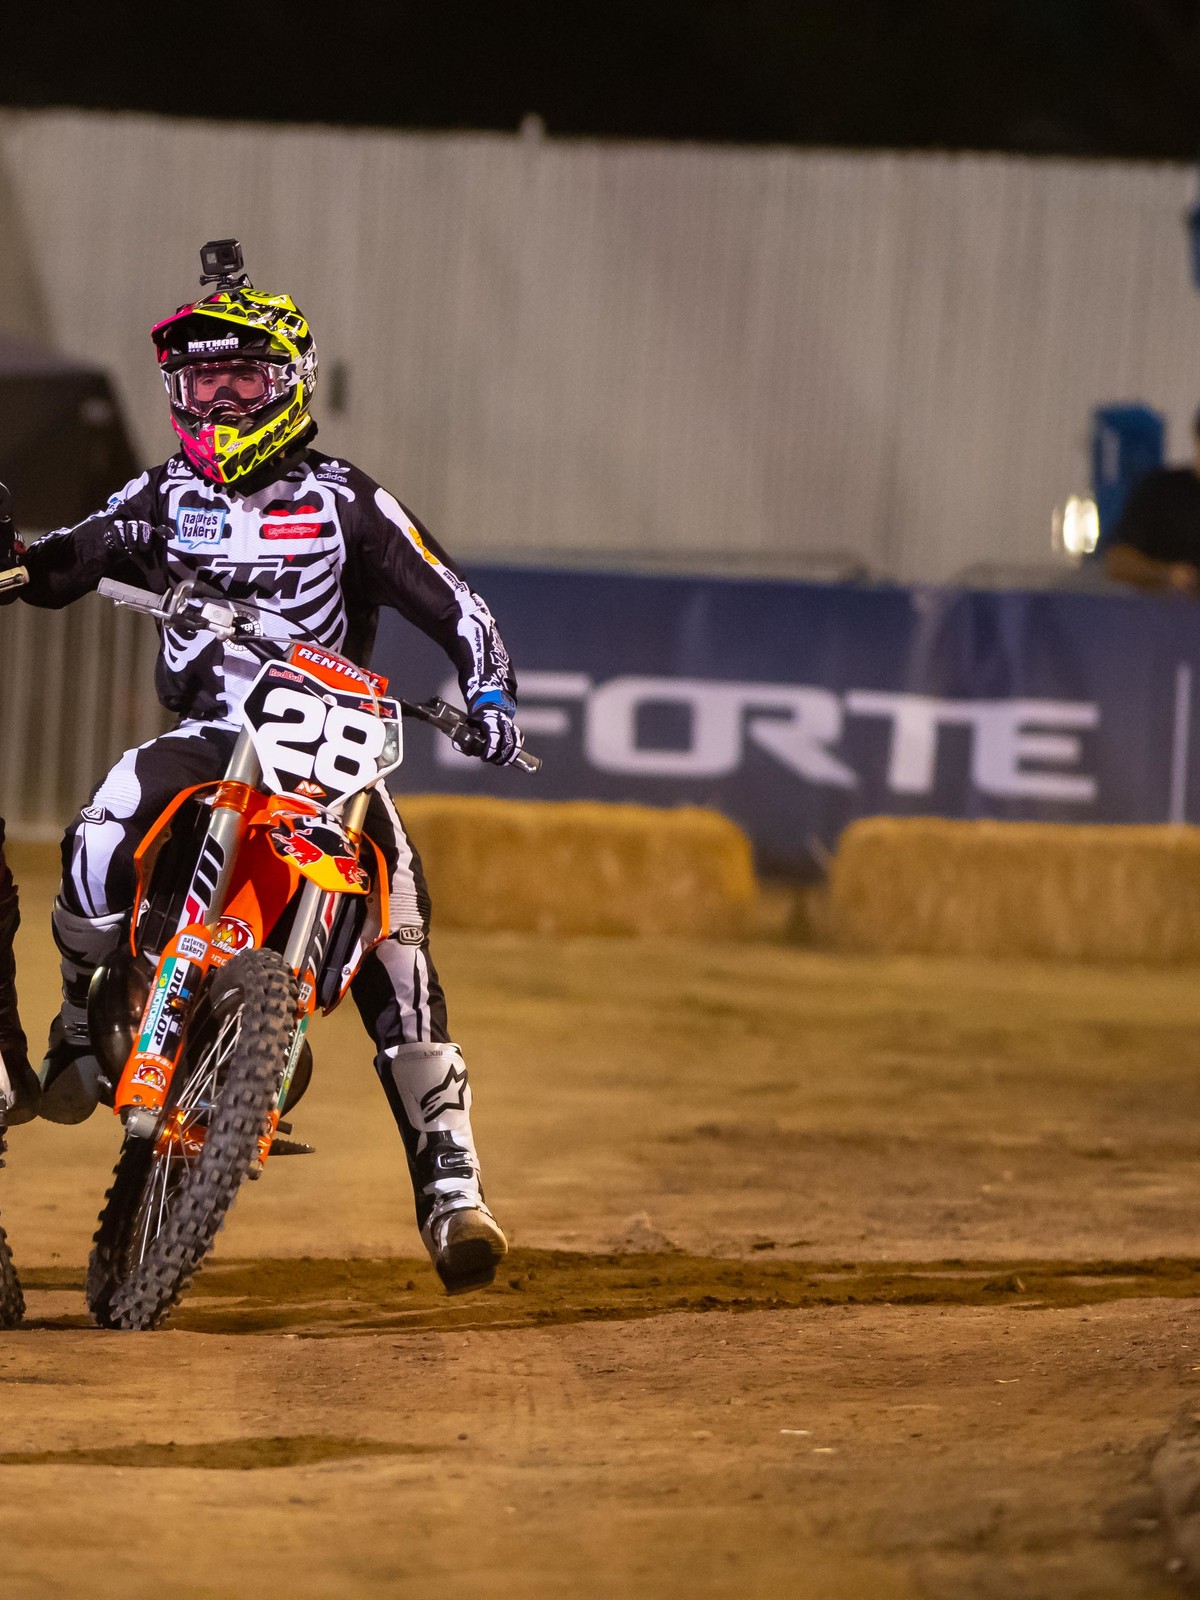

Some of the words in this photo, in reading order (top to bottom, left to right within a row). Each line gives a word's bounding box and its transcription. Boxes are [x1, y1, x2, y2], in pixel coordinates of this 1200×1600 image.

[187, 337, 239, 350] METHOD
[316, 472, 348, 484] adidas
[194, 562, 302, 600] KTM
[297, 647, 382, 690] RENTHAL
[256, 686, 387, 794] 28
[141, 987, 166, 1036] MOTOREX
